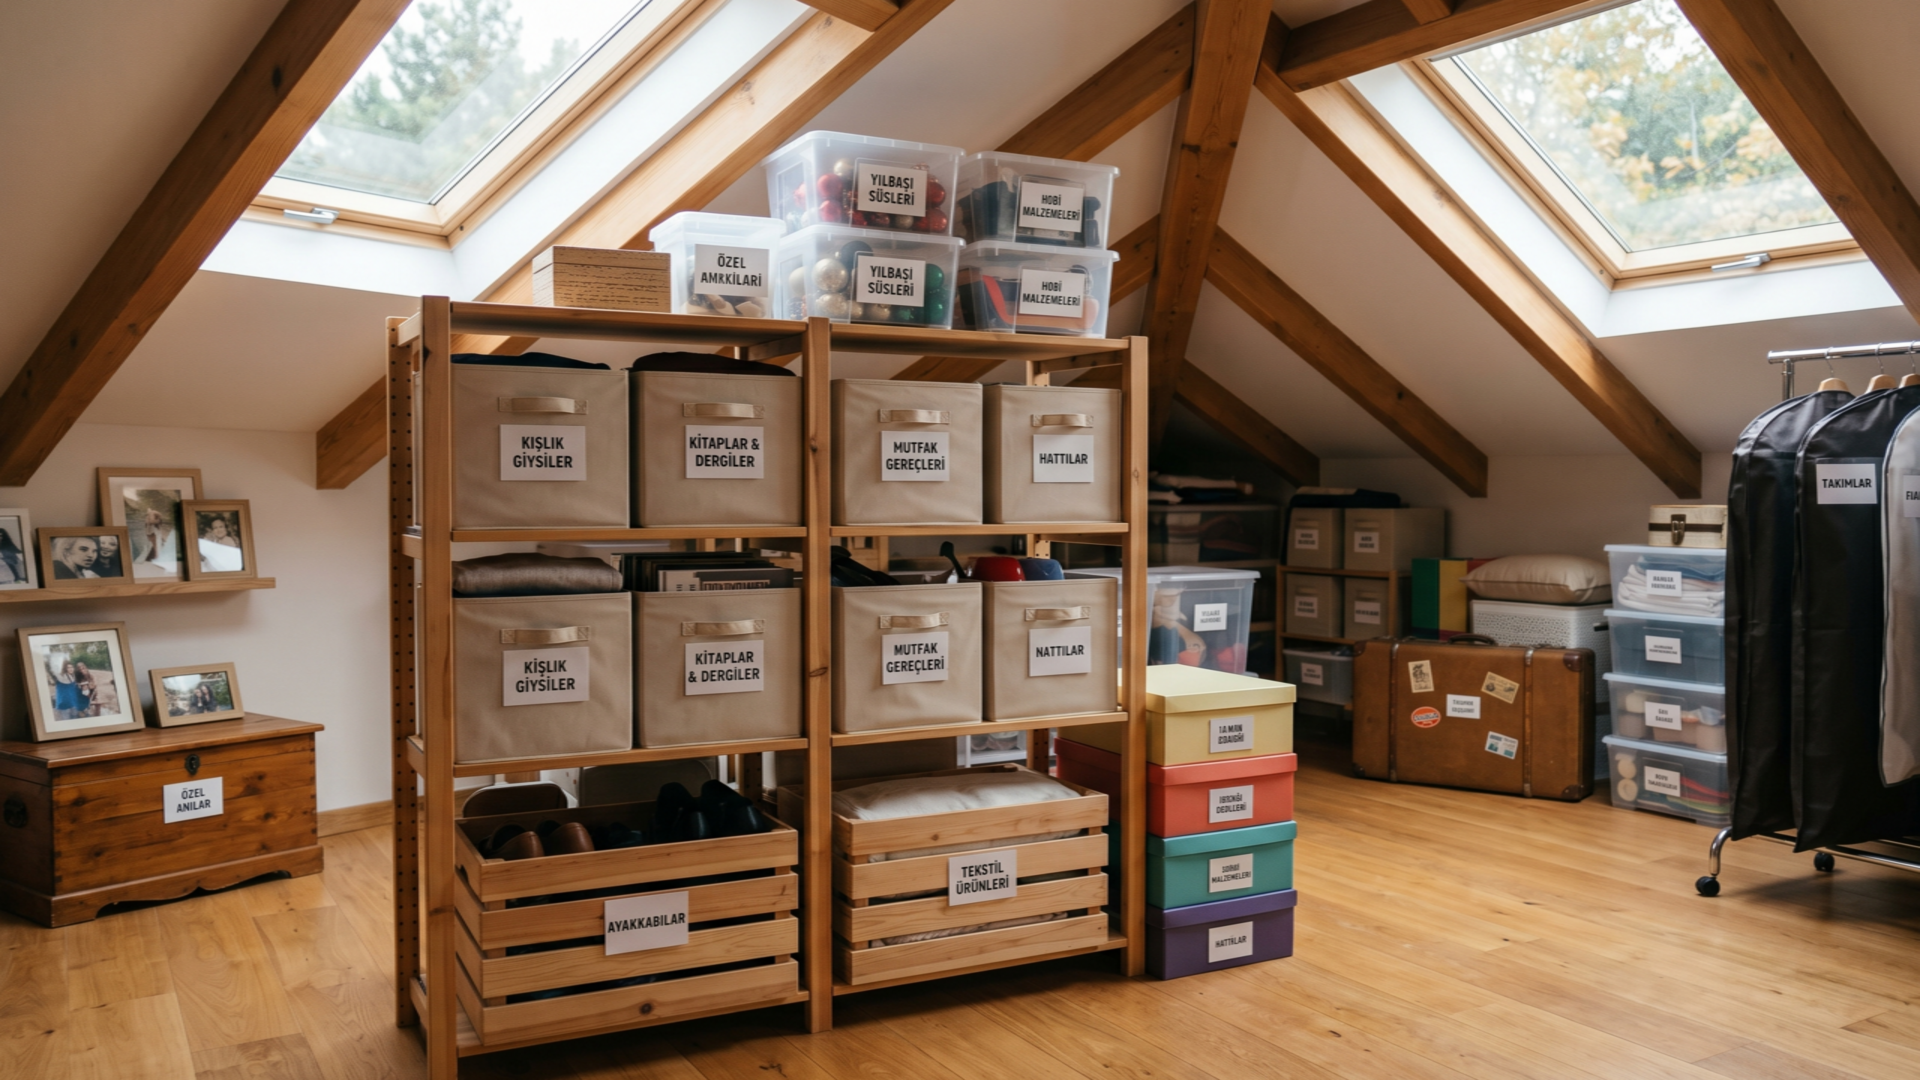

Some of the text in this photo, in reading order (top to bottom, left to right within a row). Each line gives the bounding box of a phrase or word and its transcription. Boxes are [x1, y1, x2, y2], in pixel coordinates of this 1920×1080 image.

[868, 188, 915, 206] SÜSLERİ
[1041, 194, 1062, 206] HOBİ
[717, 253, 747, 269] ÖZEL
[867, 280, 915, 296] SÜSLERİ
[1041, 280, 1063, 292] HOBİ
[521, 436, 565, 452] KIŞLIK
[689, 433, 760, 450] KİTAPLAR &
[893, 441, 938, 454] MUTFAK
[513, 452, 573, 468] GİYSİLER
[695, 452, 755, 467] DERGİLER
[886, 456, 945, 473] GEREÇLERİ
[1039, 453, 1088, 464] HATTILAR
[1821, 479, 1872, 489] TAKIMLAR
[893, 642, 938, 656] MUTFAK
[1036, 644, 1085, 658] NATTILAR
[695, 650, 754, 665] KİTAPLAR
[886, 656, 945, 674] GEREÇLERİ
[524, 658, 567, 677] KİŞLIK
[688, 666, 760, 683] & DERGİLER
[515, 676, 576, 693] GİYSİLER
[181, 787, 206, 799] ÖZEL
[176, 799, 211, 813] ANILAR
[961, 860, 1004, 878] TEKSTİL
[956, 874, 1009, 895] ÜRÜNLERİ
[607, 912, 686, 933] AYAKKABILAR
